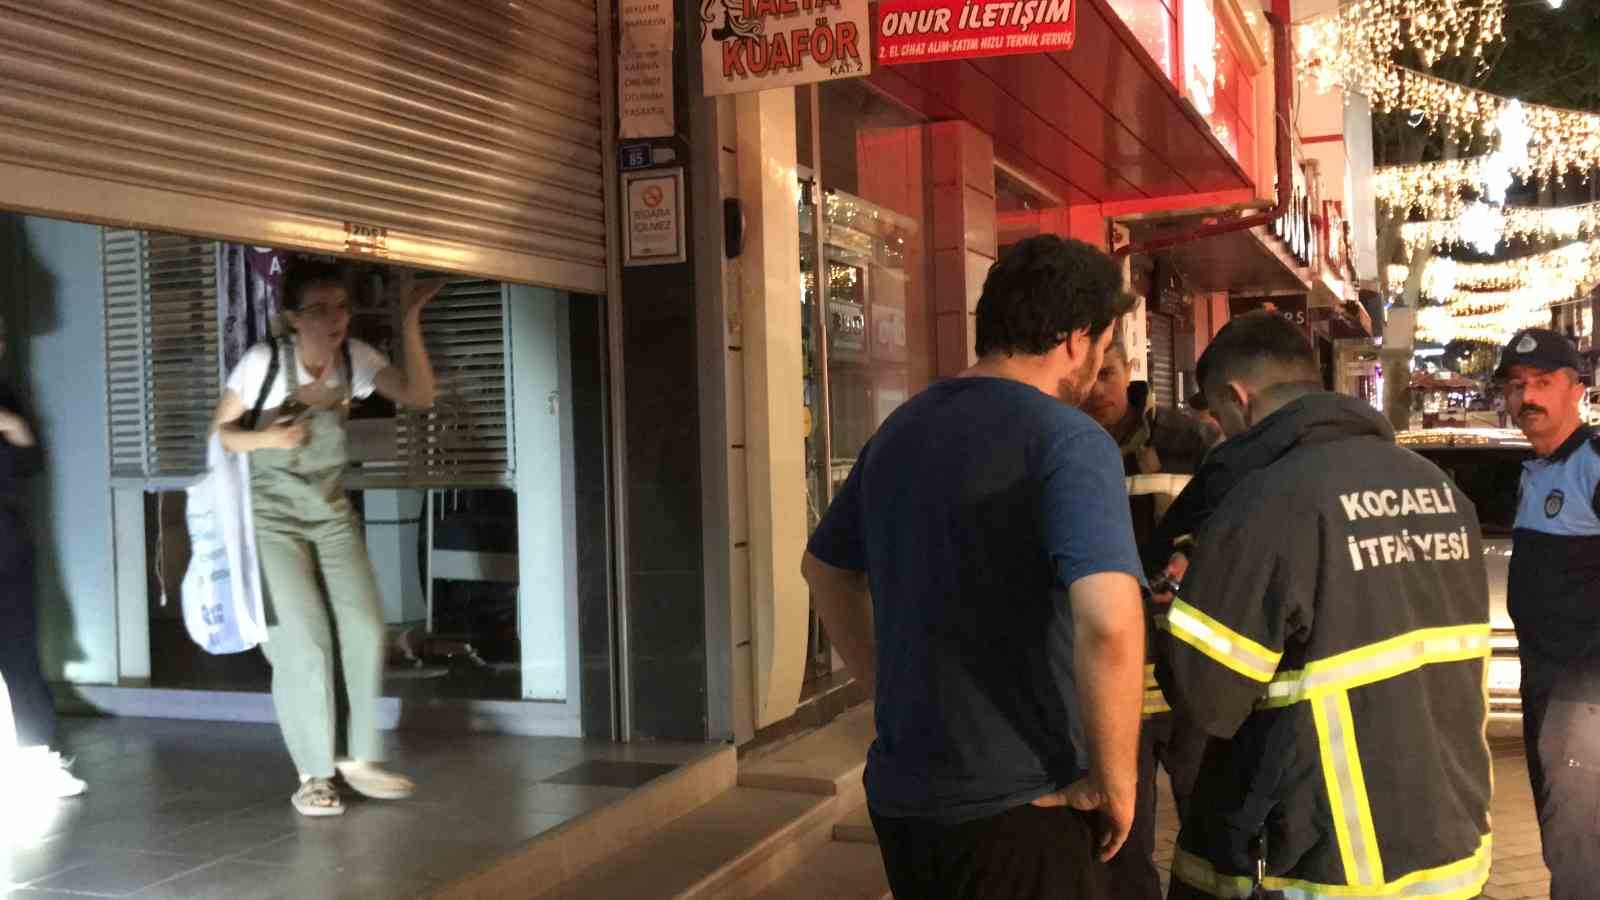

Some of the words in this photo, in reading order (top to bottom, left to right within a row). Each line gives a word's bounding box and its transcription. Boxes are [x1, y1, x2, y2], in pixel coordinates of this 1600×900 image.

[882, 8, 951, 36] ONUR
[722, 17, 860, 77] KUAFÖR
[857, 62, 864, 71] 2
[1339, 482, 1457, 521] KOCAELİ
[1348, 526, 1470, 571] İTFAİYESİ
